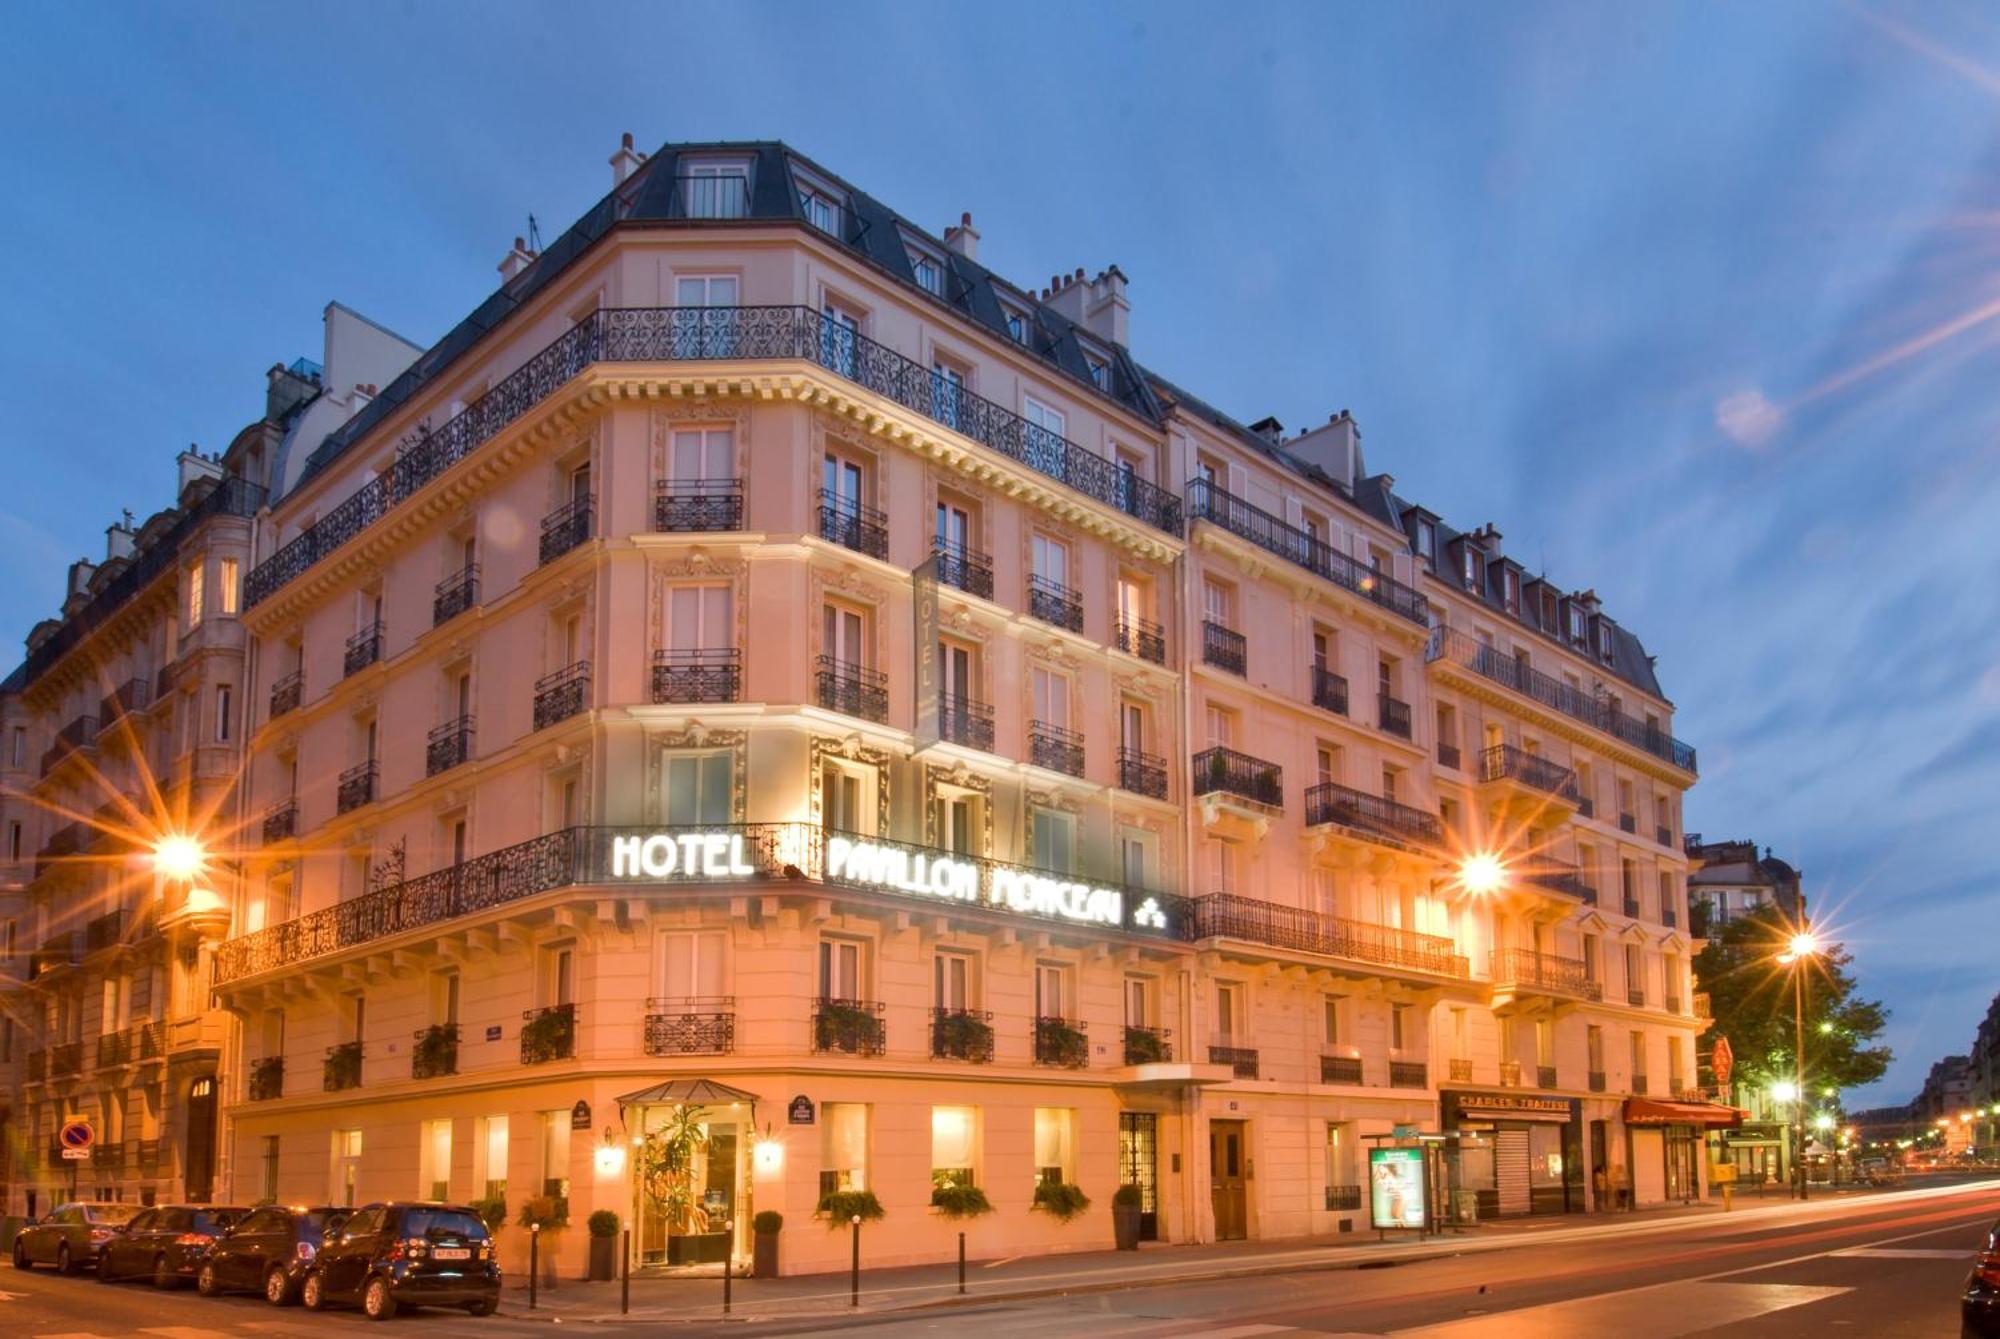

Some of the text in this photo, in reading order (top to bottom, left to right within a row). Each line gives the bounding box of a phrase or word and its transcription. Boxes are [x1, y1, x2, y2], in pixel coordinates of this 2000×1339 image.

[919, 577, 935, 686] HOTEL
[613, 834, 755, 877] HOTEL
[829, 837, 978, 902] PAVILLON
